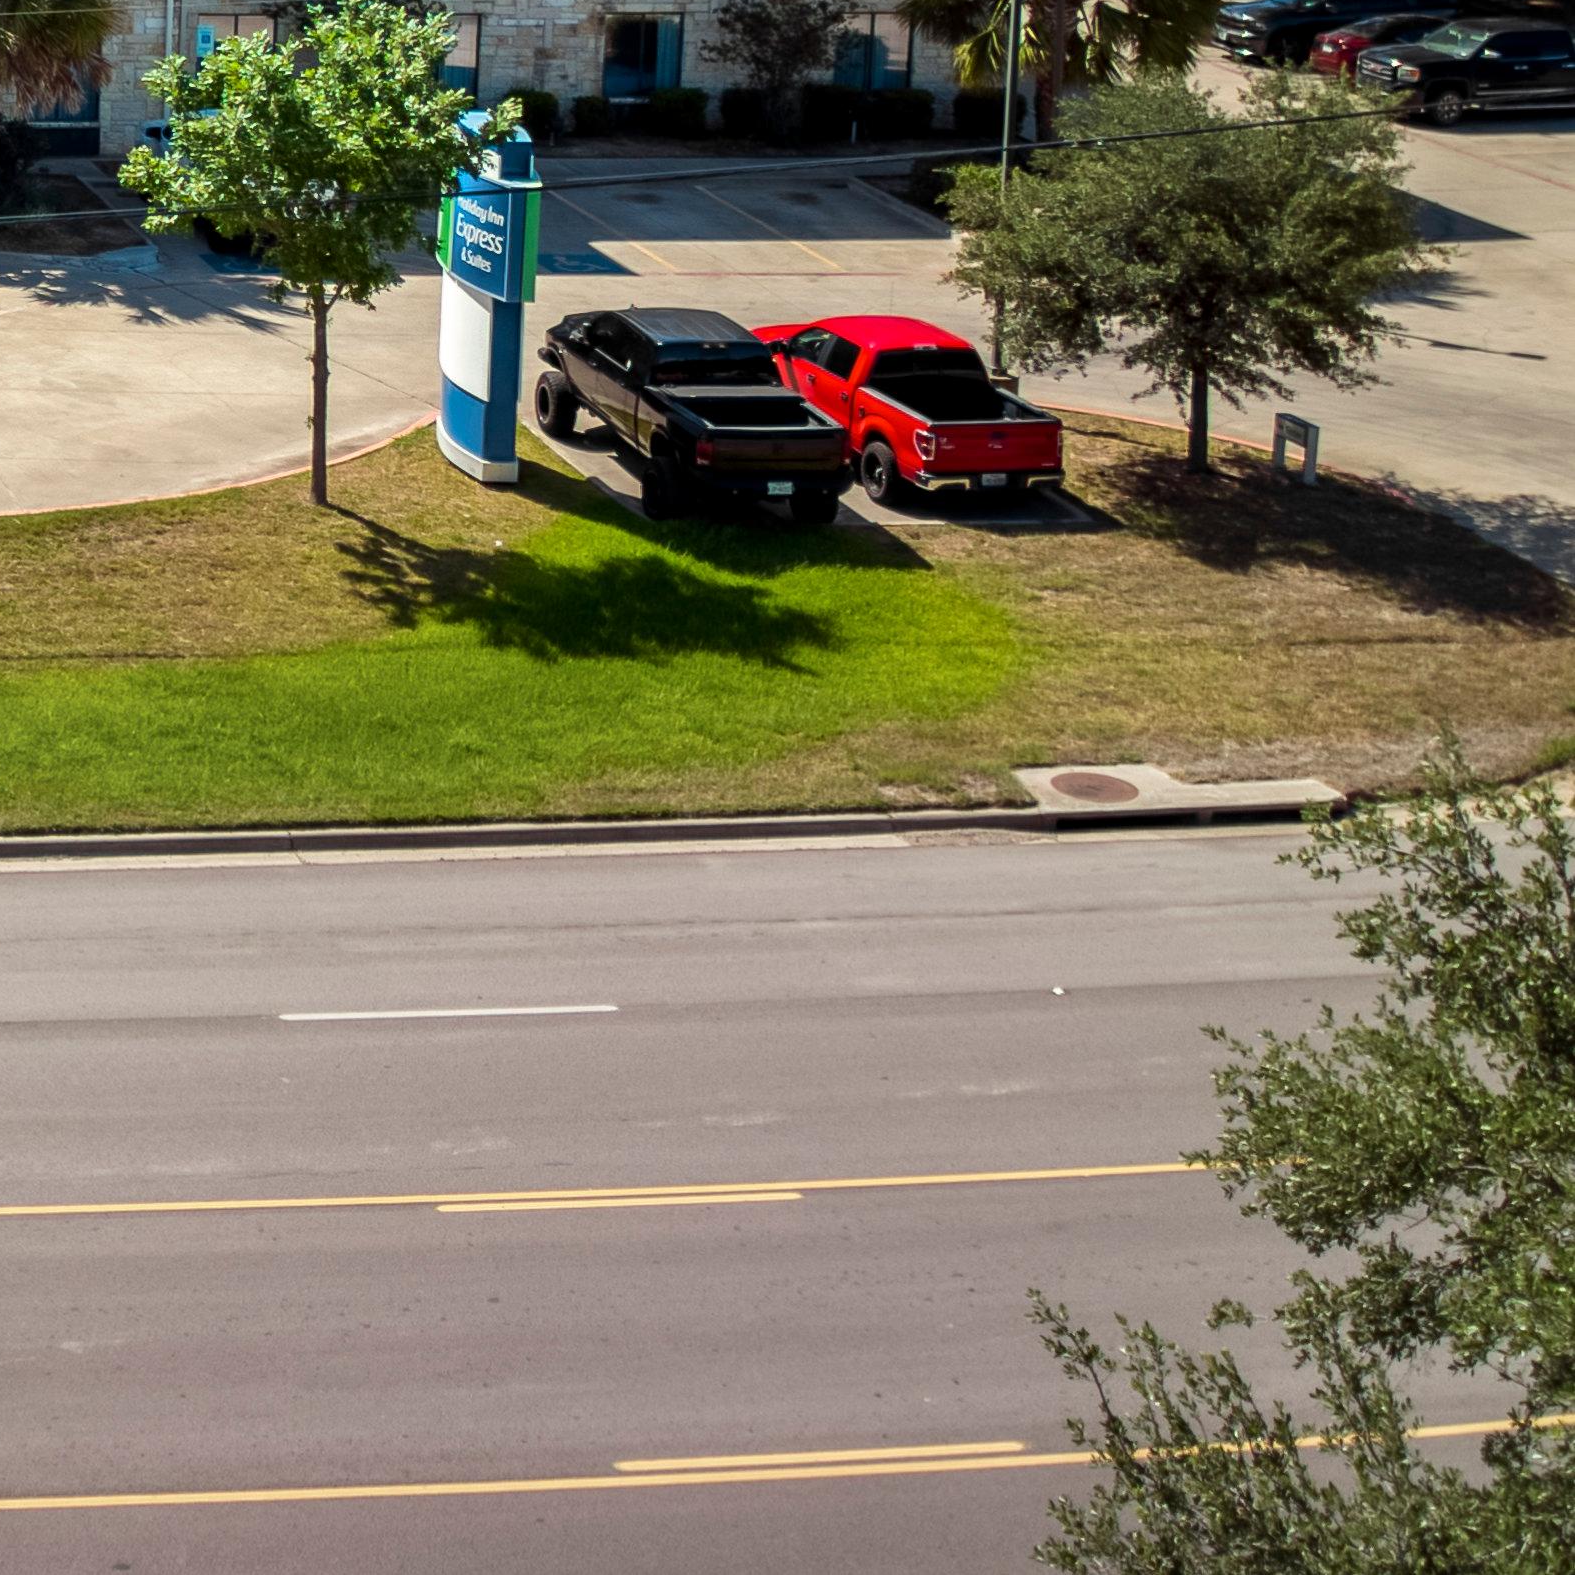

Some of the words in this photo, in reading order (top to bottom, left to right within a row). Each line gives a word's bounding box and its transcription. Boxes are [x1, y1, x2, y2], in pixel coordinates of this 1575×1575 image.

[457, 196, 488, 223] Holiday
[487, 205, 505, 227] Inn
[455, 212, 504, 255] Express
[466, 249, 492, 273] Suites
